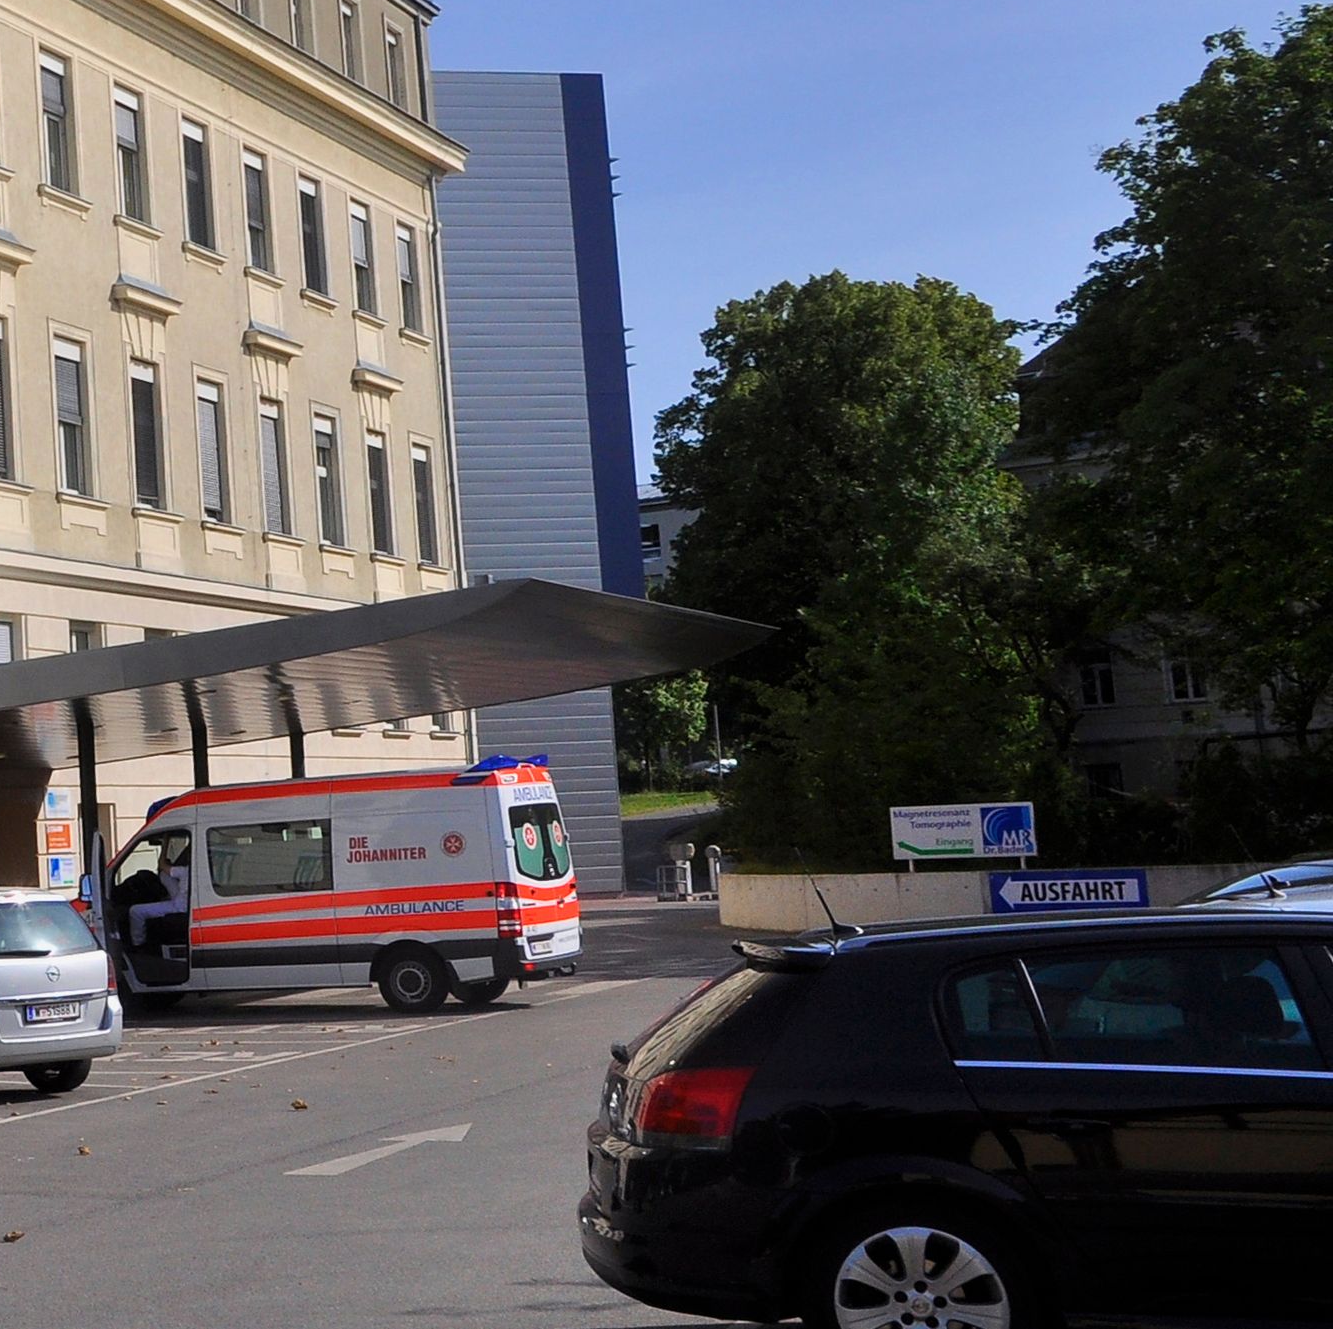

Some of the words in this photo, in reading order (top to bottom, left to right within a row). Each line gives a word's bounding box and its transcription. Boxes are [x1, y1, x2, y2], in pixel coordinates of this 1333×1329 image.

[893, 808, 970, 820] Magnetresonanz
[910, 820, 971, 830] Tomographie
[349, 836, 369, 849] DIE
[935, 838, 974, 847] Eingang
[346, 847, 427, 863] JOHANNITER
[1020, 881, 1126, 902] AUSFAHRT
[363, 900, 465, 915] AMBULANCE
